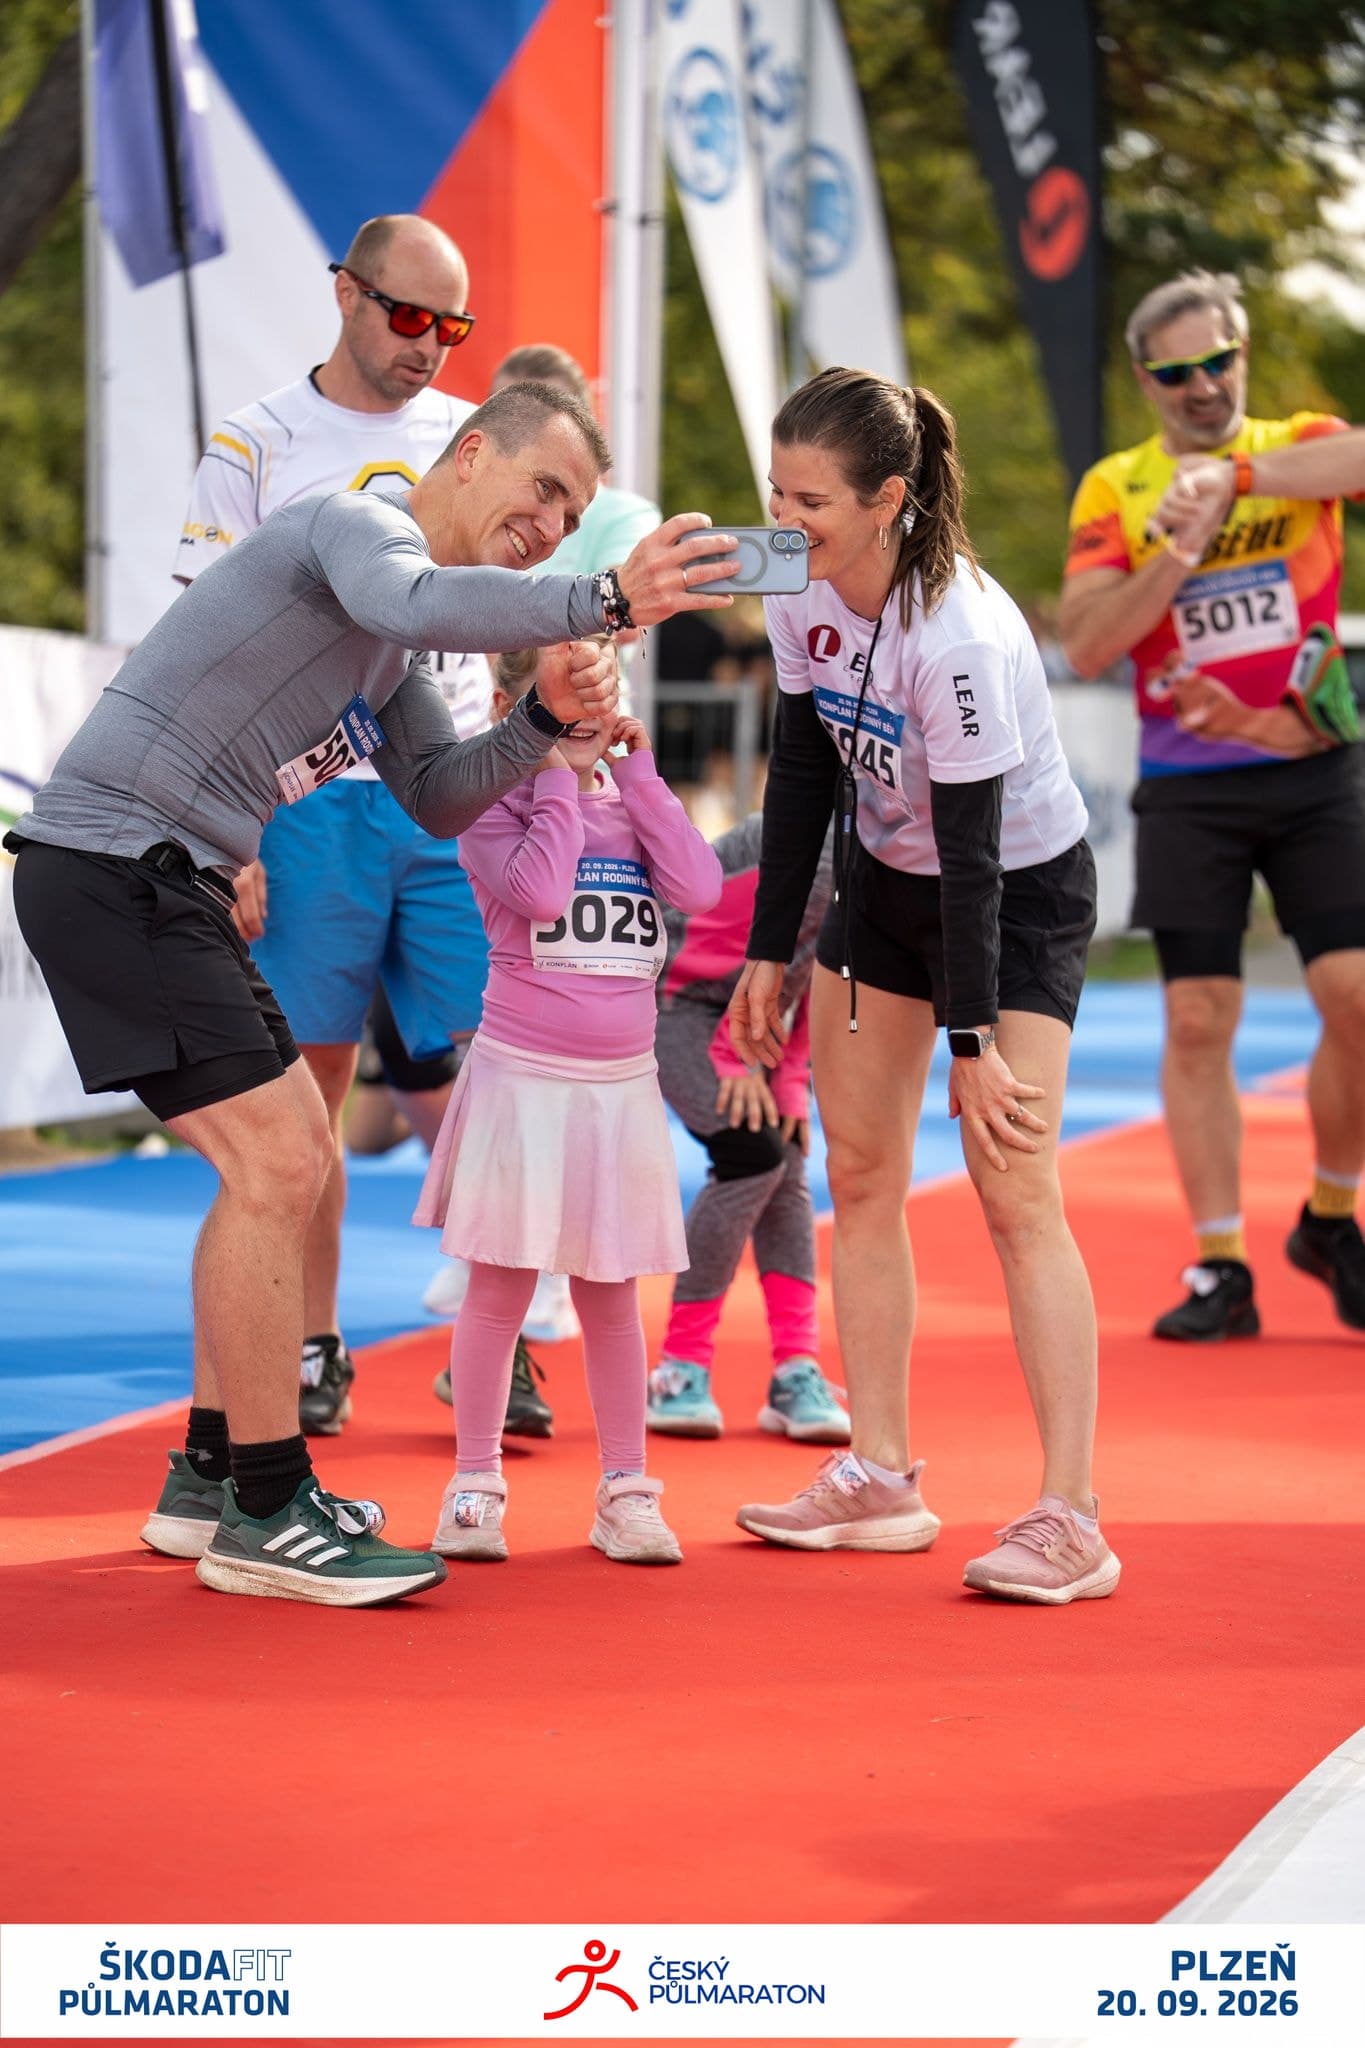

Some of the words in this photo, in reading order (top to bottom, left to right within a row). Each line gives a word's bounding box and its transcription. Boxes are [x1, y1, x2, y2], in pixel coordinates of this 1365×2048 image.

[1184, 588, 1281, 642] 5012
[818, 698, 852, 719] KONPLAN
[953, 674, 980, 738] LEAR
[575, 871, 600, 882] LAN
[602, 872, 641, 886] RODINNÝ
